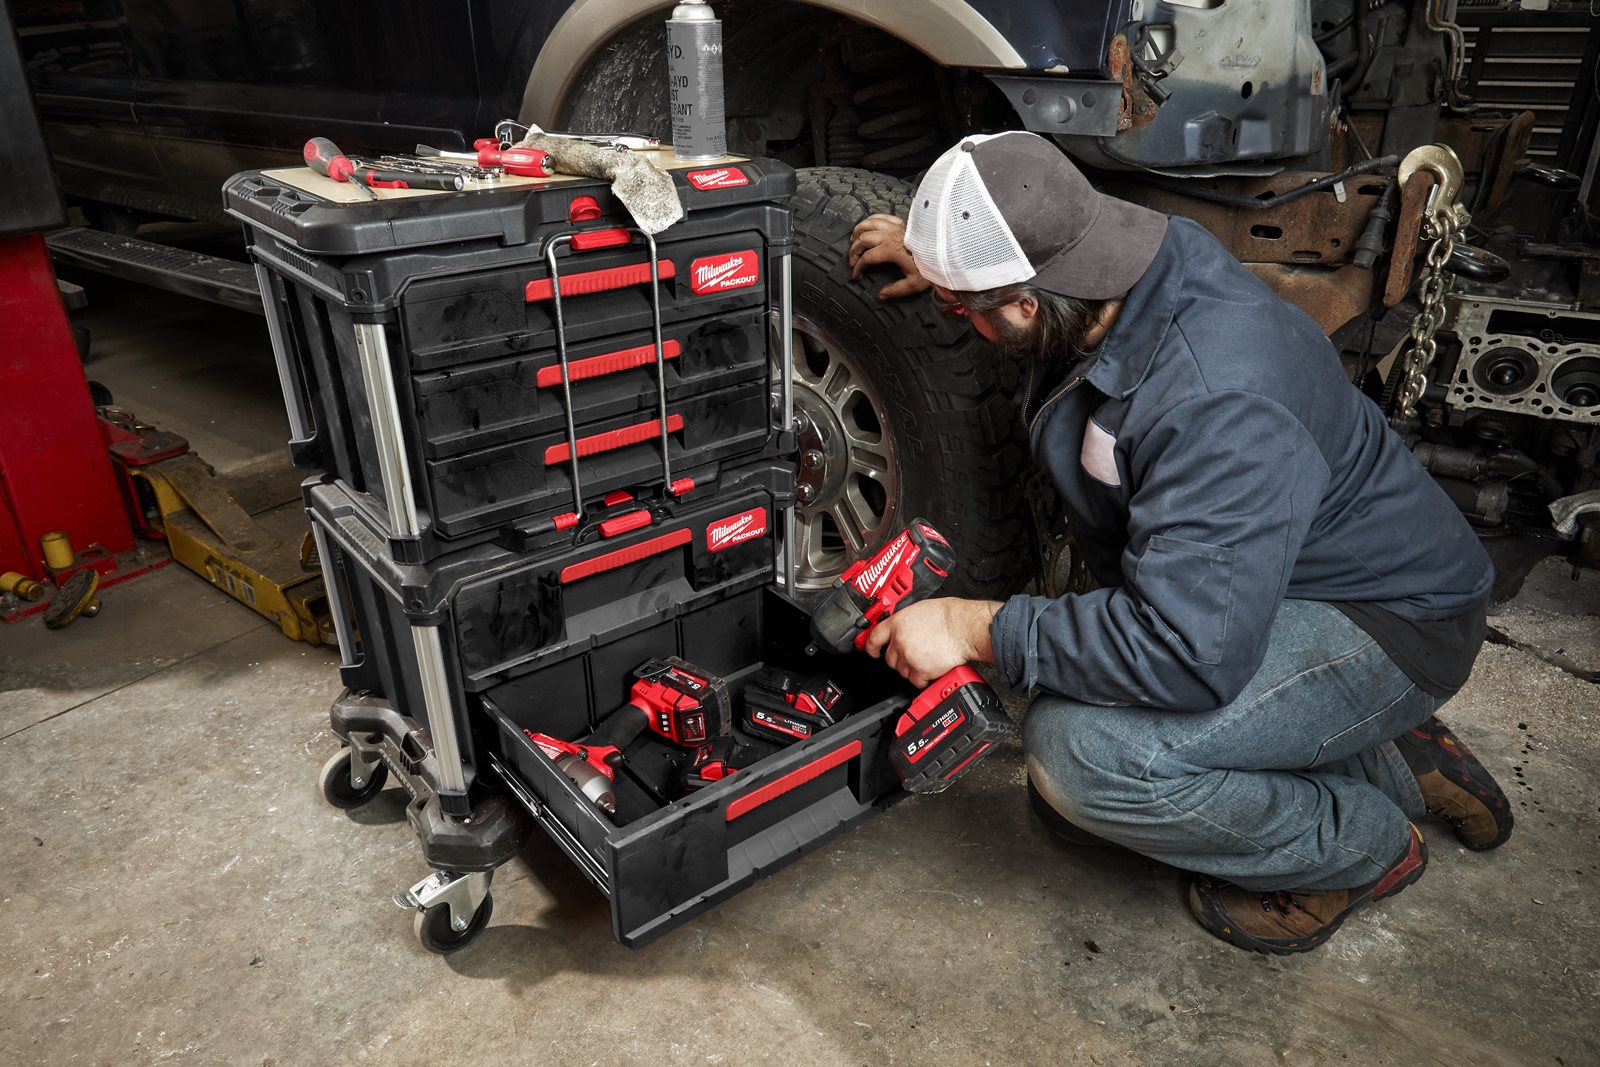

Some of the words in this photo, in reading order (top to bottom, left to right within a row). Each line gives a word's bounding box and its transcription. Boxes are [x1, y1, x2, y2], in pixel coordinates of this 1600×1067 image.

[671, 103, 693, 116] RANT
[692, 169, 729, 184] Milwaukee
[718, 178, 747, 186] PACKOUT
[695, 256, 744, 285] Milwaukee
[720, 275, 757, 288] PACKOUT
[710, 514, 753, 544] Milwaukee
[732, 527, 765, 543] PACKOUT
[854, 534, 908, 593] Milwaukee
